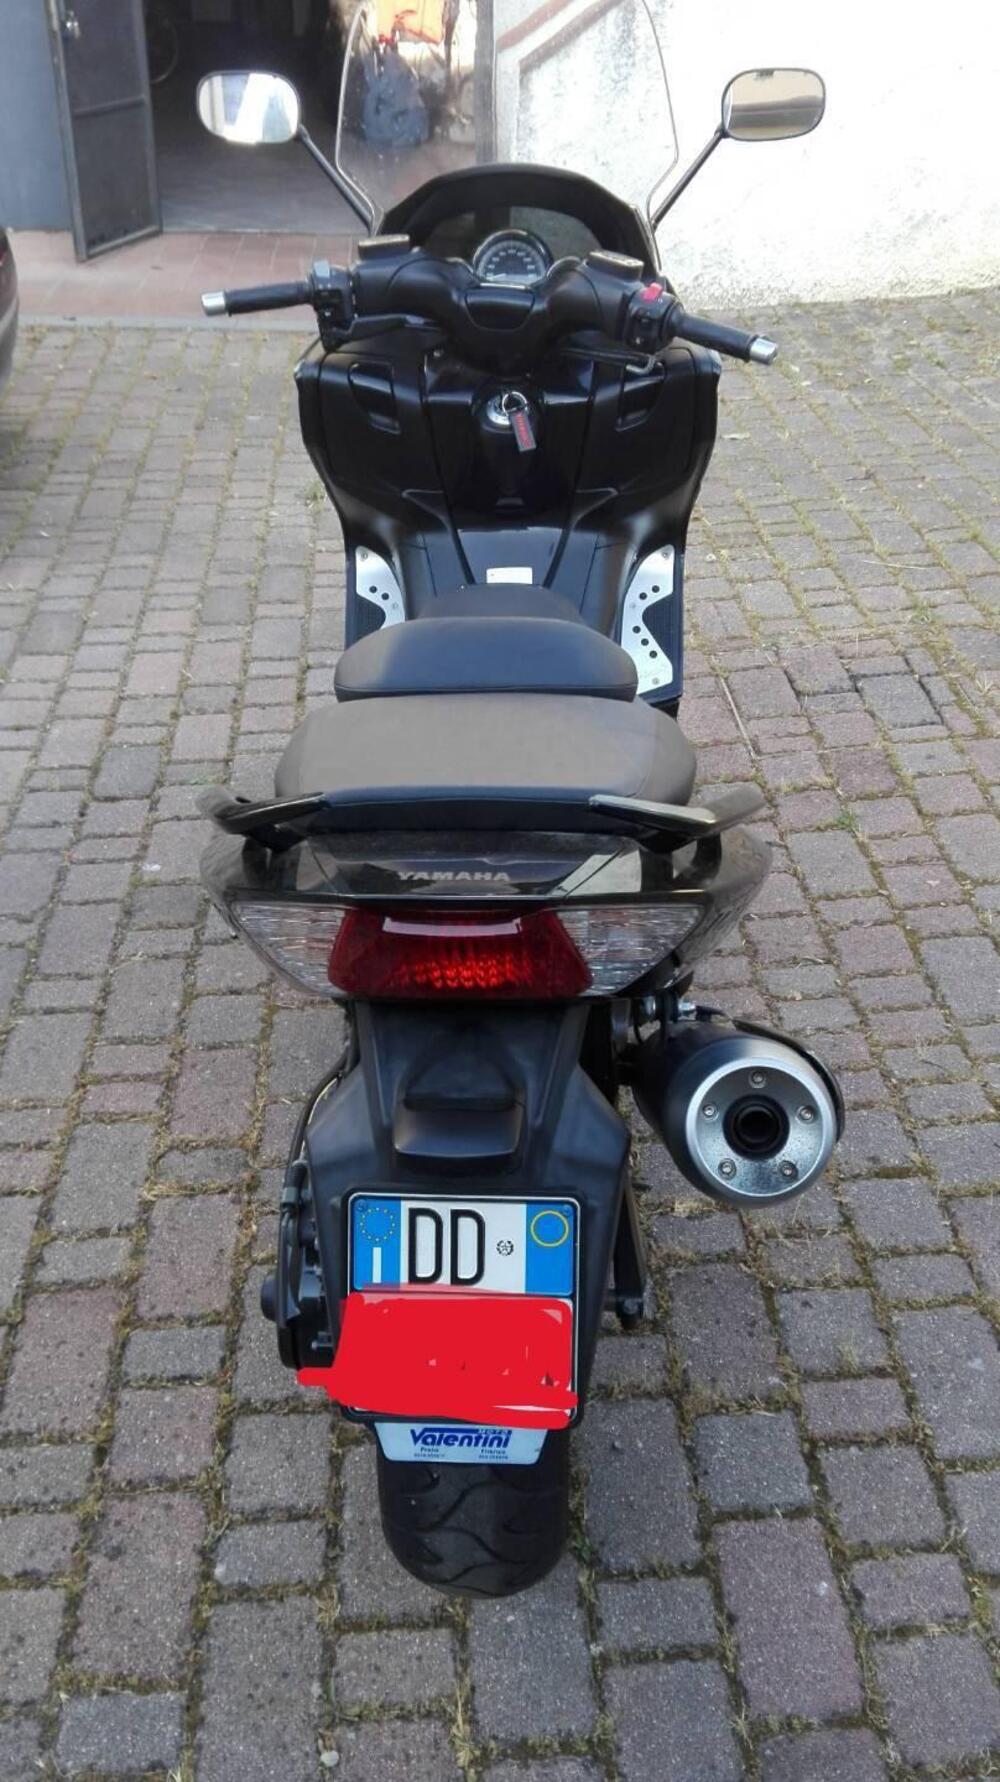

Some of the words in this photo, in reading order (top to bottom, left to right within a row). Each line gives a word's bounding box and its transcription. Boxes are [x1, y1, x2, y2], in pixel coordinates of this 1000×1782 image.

[398, 871, 511, 881] YAMAHA
[408, 1207, 486, 1287] DD
[410, 1427, 513, 1449] Valentini
